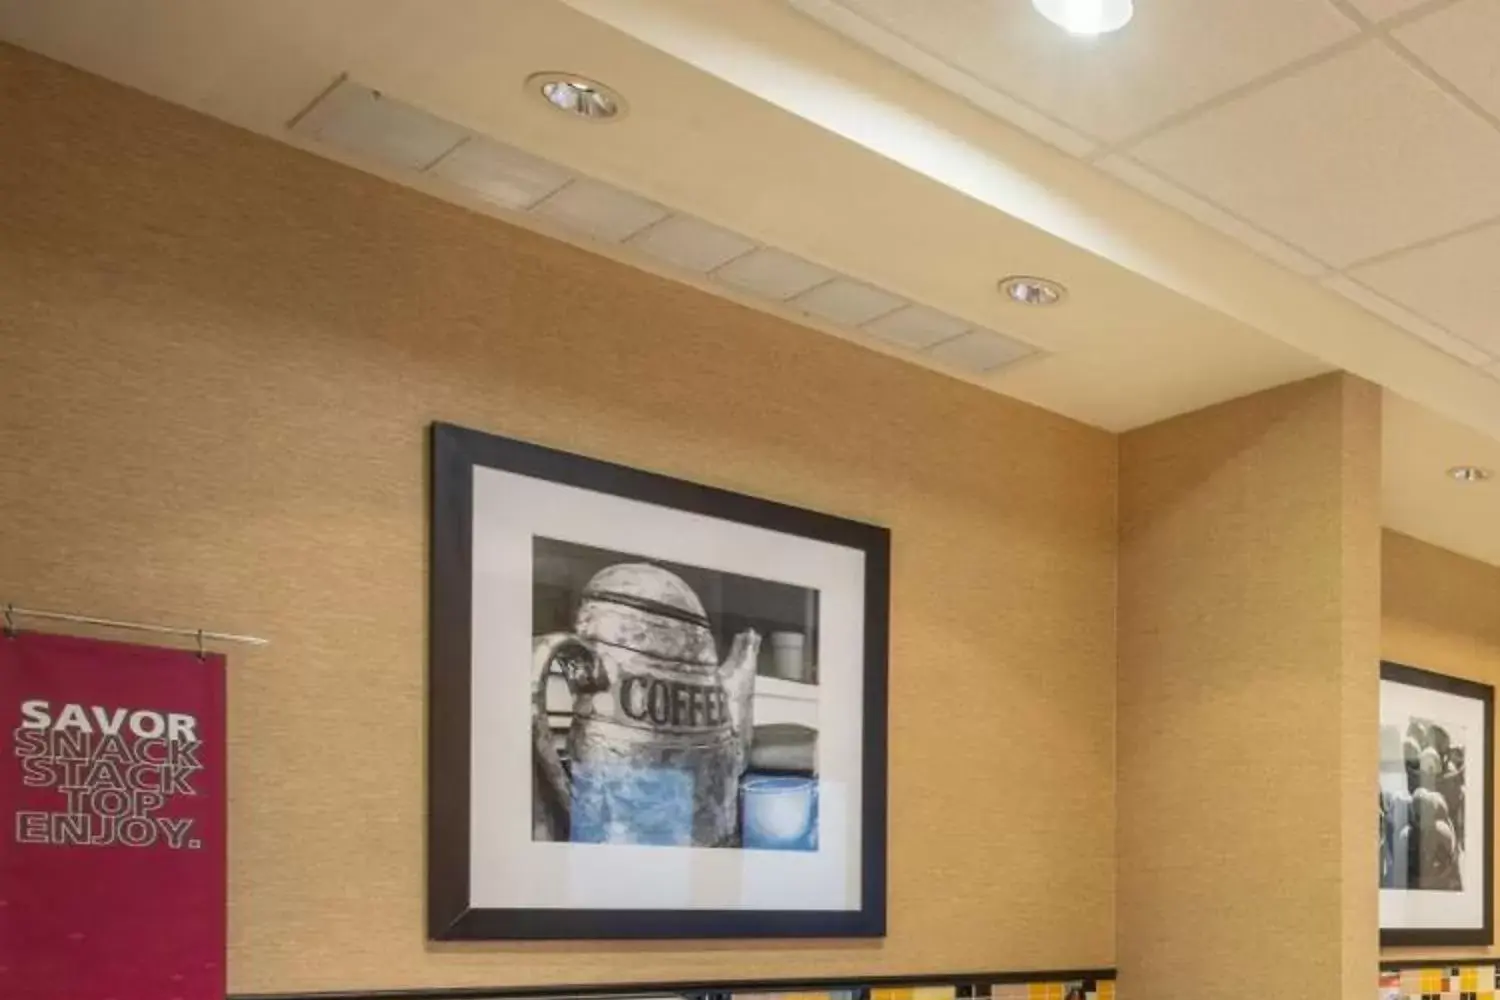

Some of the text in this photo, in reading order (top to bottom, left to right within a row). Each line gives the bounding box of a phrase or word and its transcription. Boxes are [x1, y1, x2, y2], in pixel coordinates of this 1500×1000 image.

[20, 700, 197, 741] SAVOR
[14, 726, 204, 769] SNACK
[23, 755, 197, 795] STACK
[57, 785, 164, 819] TOP
[15, 811, 202, 849] ENJOY.
